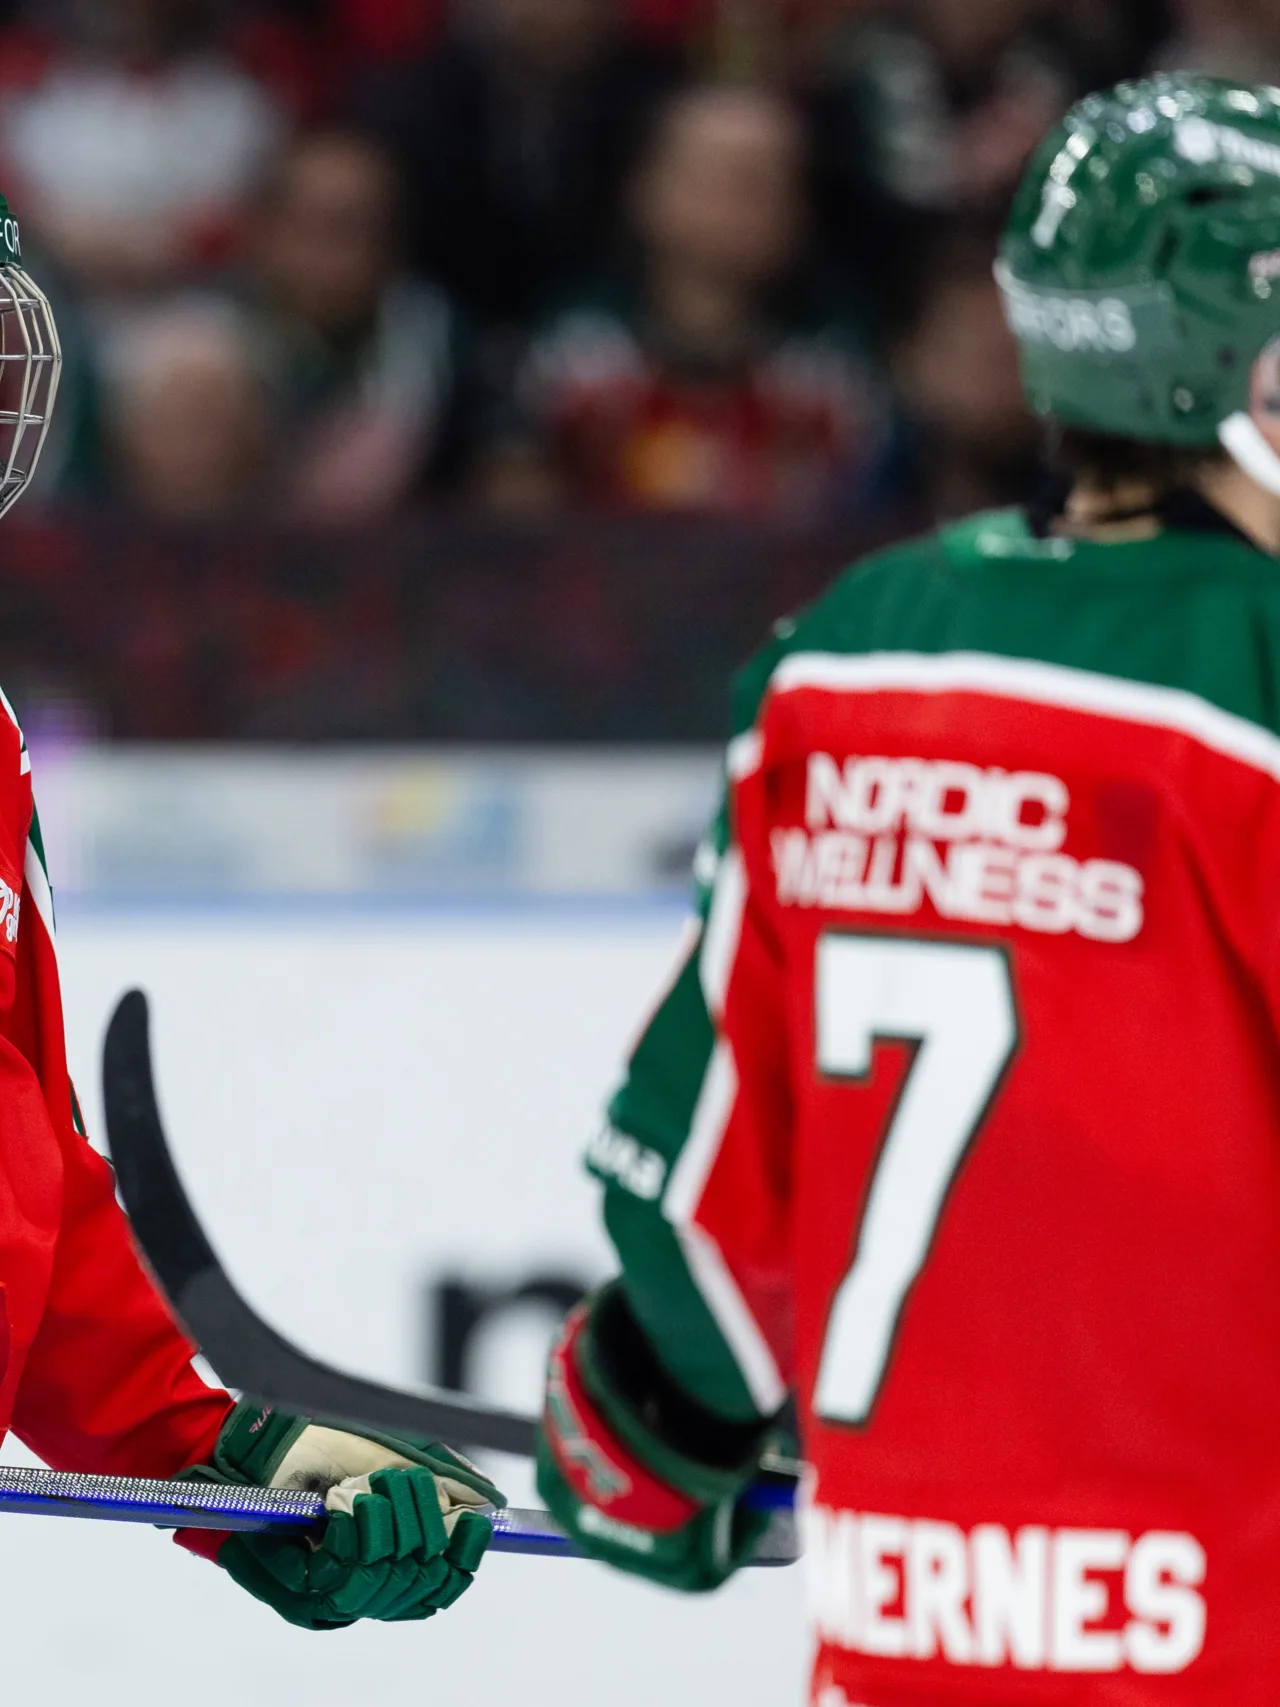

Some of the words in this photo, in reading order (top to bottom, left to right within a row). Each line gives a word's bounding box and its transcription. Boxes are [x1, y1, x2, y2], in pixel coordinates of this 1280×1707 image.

[804, 751, 1070, 852] NORDIC
[768, 826, 1145, 942] WELLNESS
[812, 930, 1020, 1424] 7
